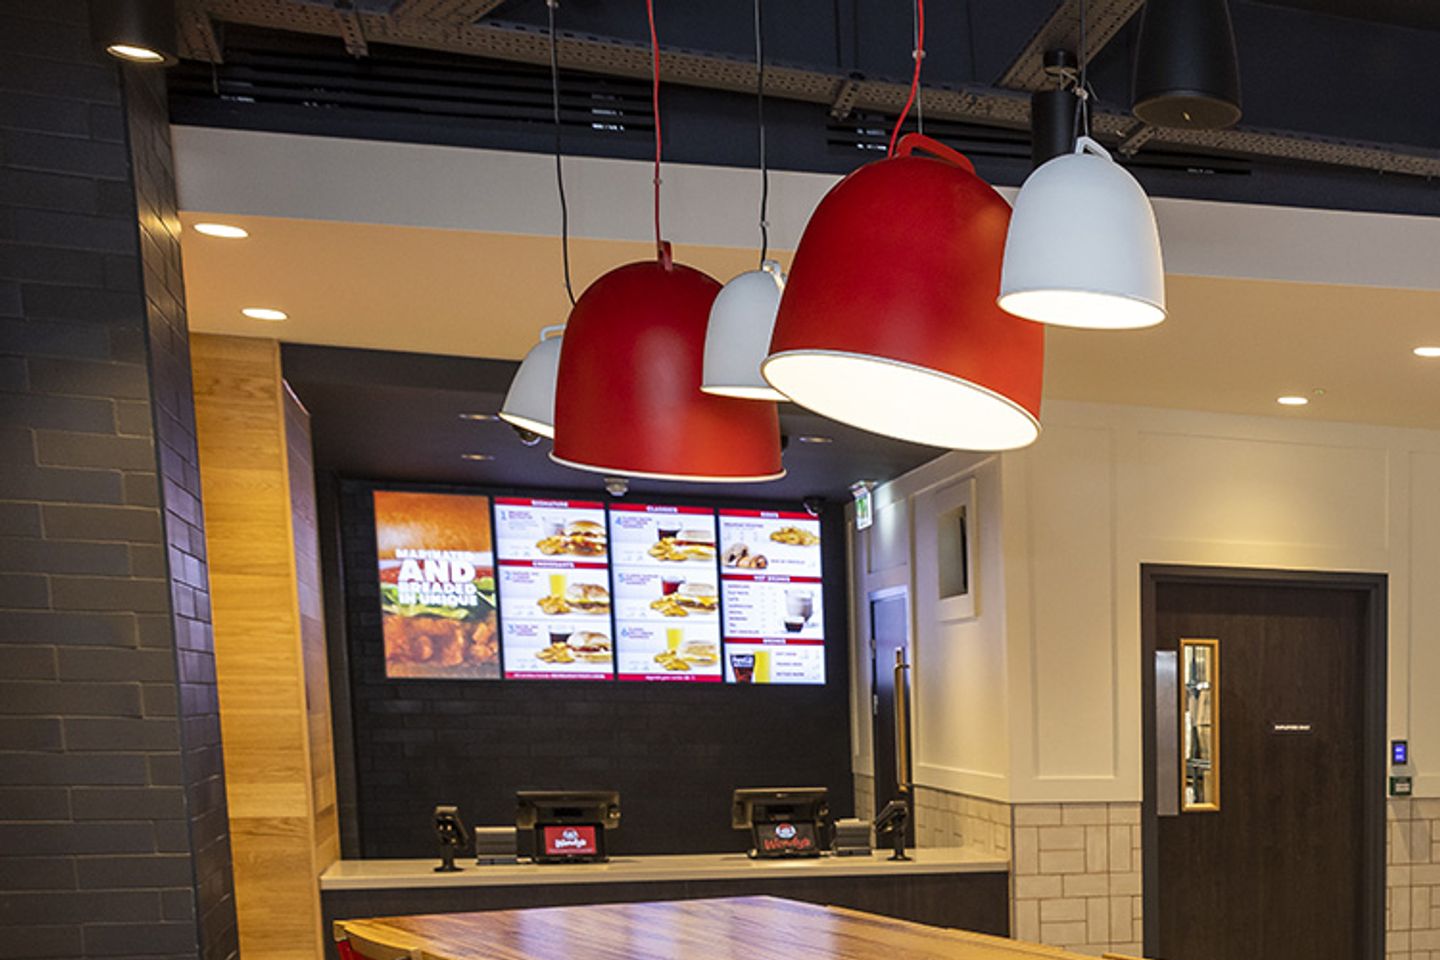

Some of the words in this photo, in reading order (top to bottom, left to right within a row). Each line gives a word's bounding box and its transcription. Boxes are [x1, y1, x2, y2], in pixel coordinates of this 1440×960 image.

[398, 557, 476, 584] AND
[398, 580, 477, 595] BREADED
[399, 591, 417, 605] IN
[419, 593, 478, 608] UNIQUE
